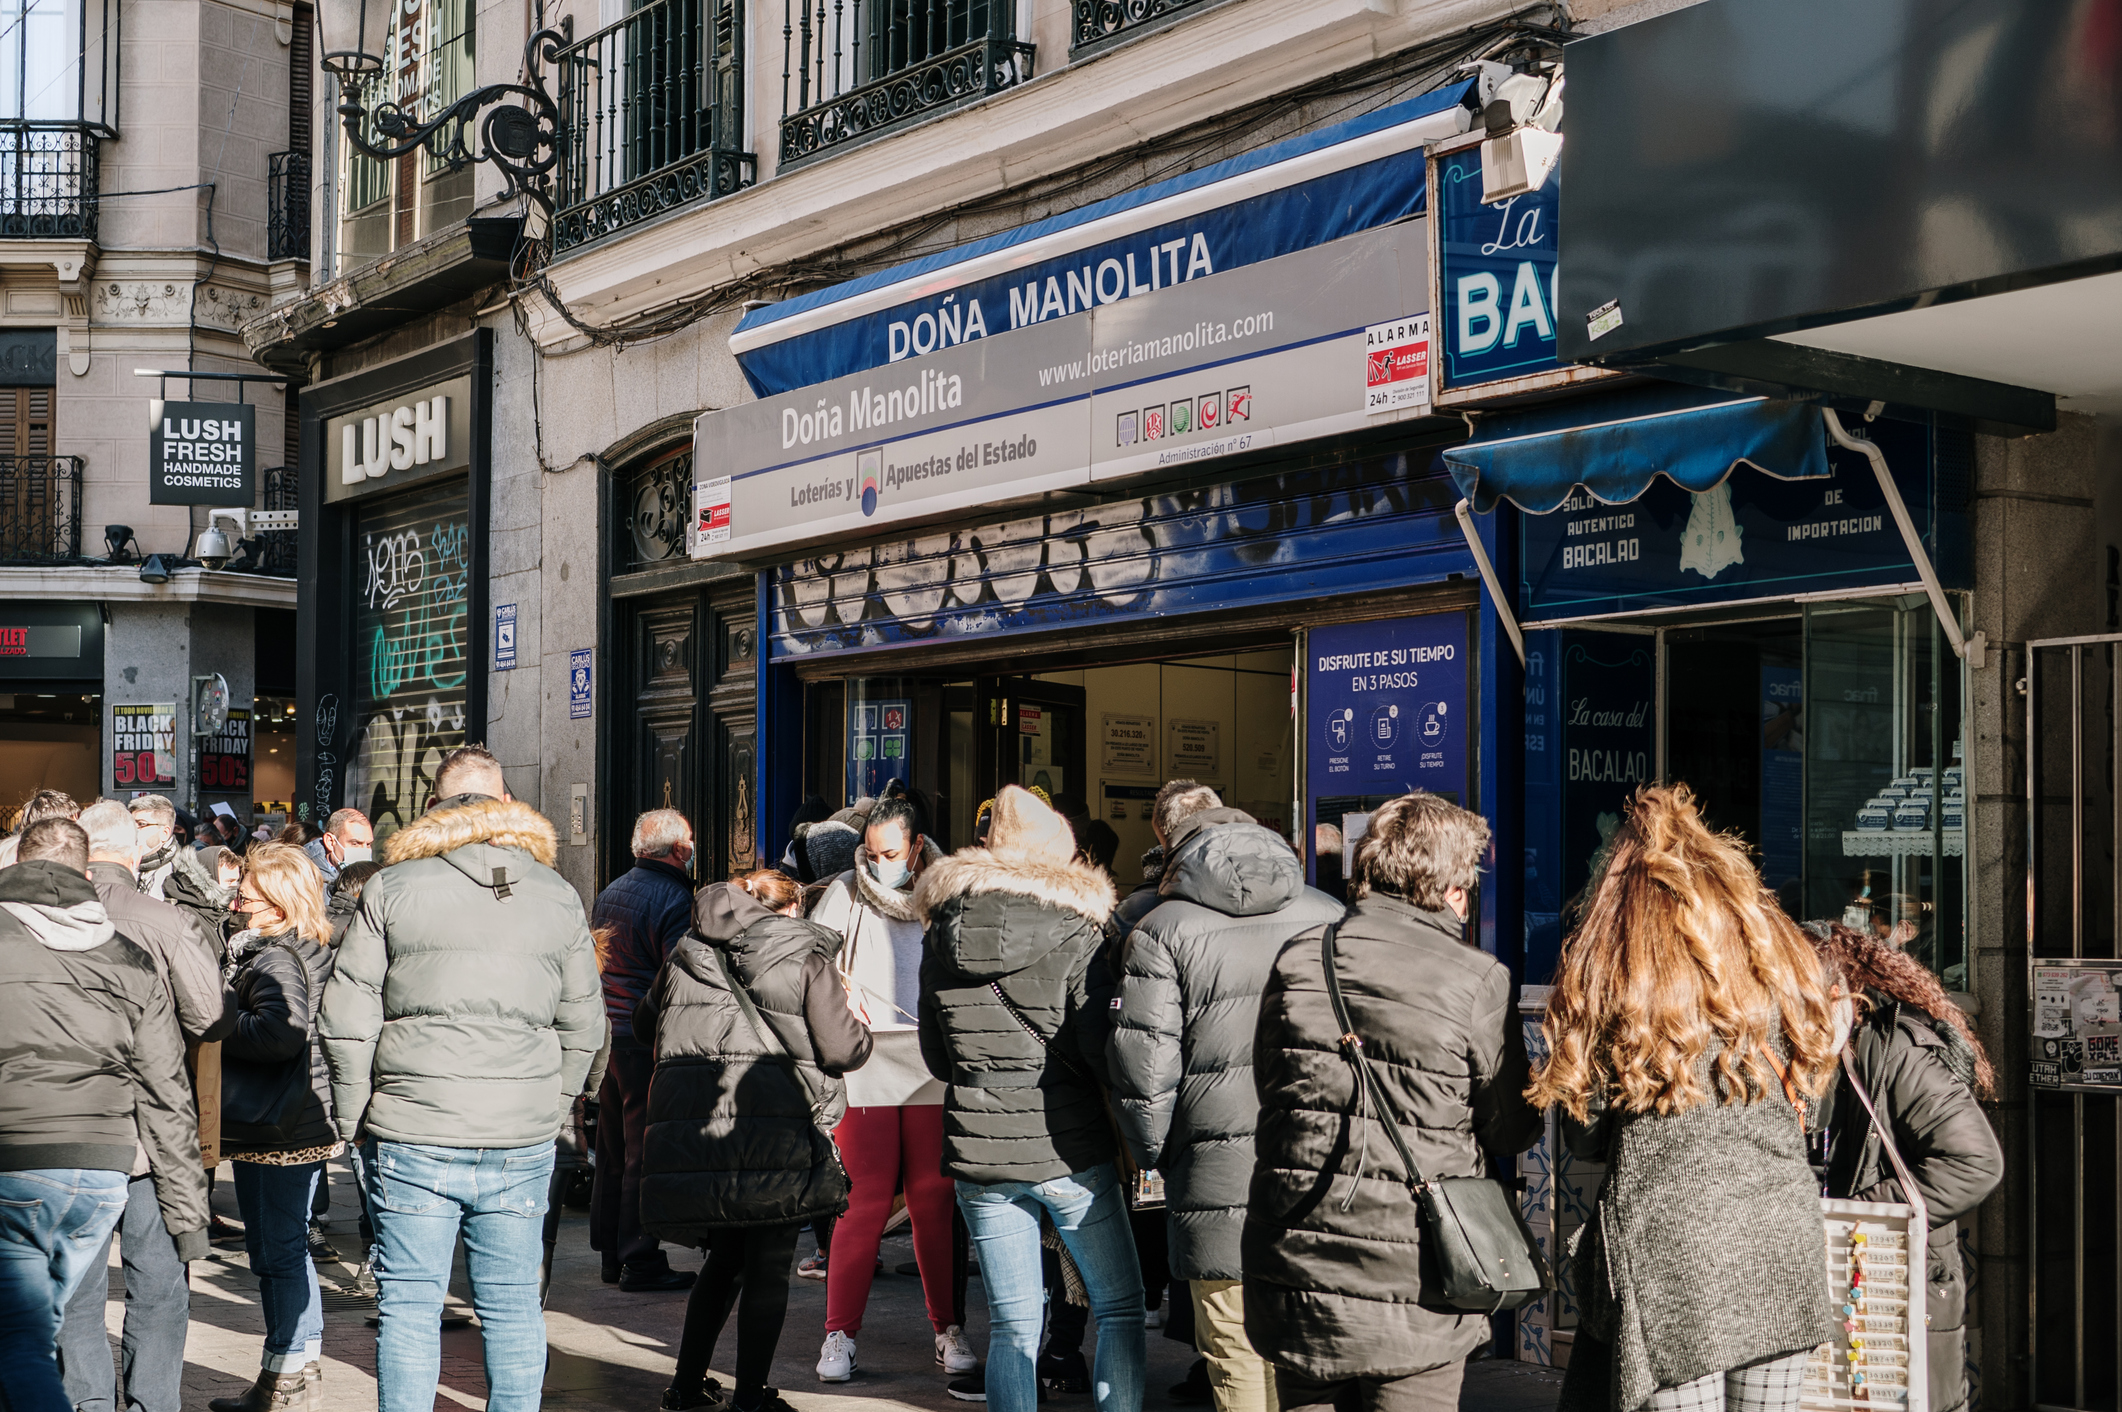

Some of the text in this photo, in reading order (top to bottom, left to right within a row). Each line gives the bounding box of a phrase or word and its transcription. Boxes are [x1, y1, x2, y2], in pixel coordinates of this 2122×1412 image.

[1481, 194, 1545, 256] La
[888, 231, 1213, 363] DOÑA MANOLITA
[1457, 261, 1558, 357] BA
[1367, 320, 1429, 346] ALARMA
[1038, 310, 1274, 387] www.loteriamanolita.com
[1396, 351, 1427, 366] LASSER
[782, 368, 962, 450] Doña Manolita
[1369, 391, 1388, 406] 24h
[163, 417, 242, 441] LUSH
[342, 395, 447, 485] LUSH
[163, 441, 242, 462] FRESH
[1158, 442, 1225, 465] Administración
[1239, 435, 1252, 450] 67
[163, 462, 242, 475] HANDMADE
[791, 433, 1037, 507] Loterías y Apuestas del Estado
[163, 475, 242, 489] COSMETICS
[1824, 489, 1843, 506] DE
[1567, 513, 1634, 536] AUTENTICO
[1788, 515, 1882, 541] IMPORTACION
[1563, 538, 1639, 569] BACALAO
[1318, 644, 1455, 672] DISFRUTE DE SU TIEMPO
[1352, 671, 1418, 692] EN 3 PASOS
[115, 715, 172, 733] BLACK
[1568, 697, 1649, 728] La casa del
[222, 720, 247, 737] ACK
[1111, 729, 1142, 739] 30.216.320
[115, 733, 174, 750] FRIDAY
[202, 737, 249, 755] FRIDAY
[1569, 748, 1646, 782] BACALAO
[2087, 1036, 2119, 1052] GORE
[2029, 1073, 2059, 1085] ETHER
[2032, 1063, 2057, 1074] UTAH
